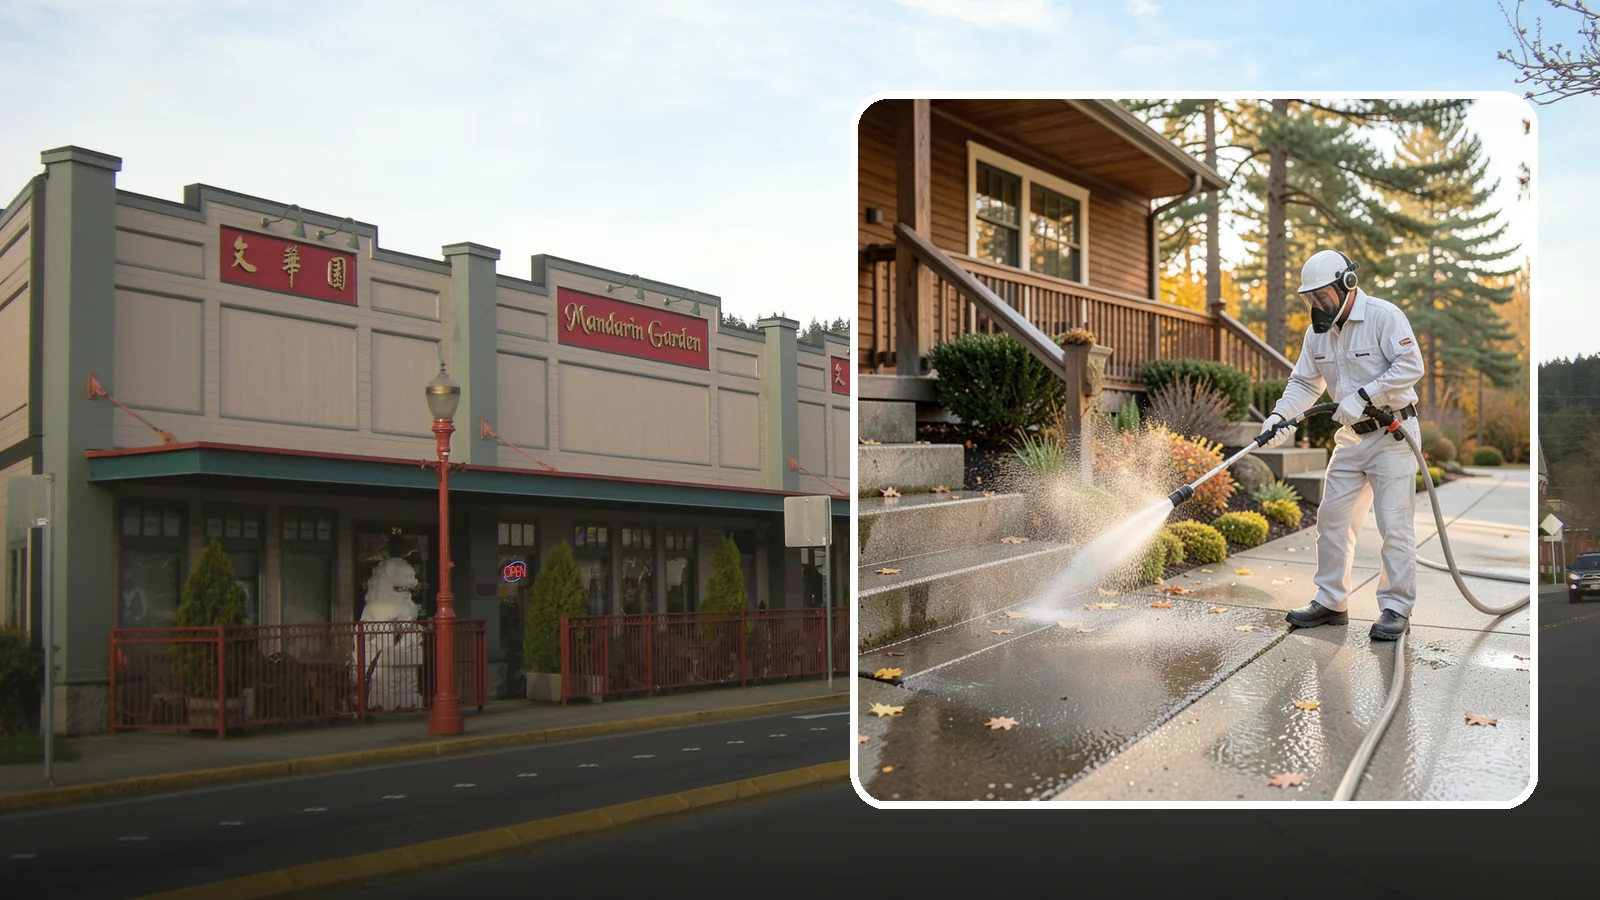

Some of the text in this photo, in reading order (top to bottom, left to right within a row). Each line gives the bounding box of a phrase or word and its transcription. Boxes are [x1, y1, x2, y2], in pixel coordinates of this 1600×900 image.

[231, 236, 346, 291] 文華園
[564, 302, 701, 352] Mandarin Garden
[503, 565, 527, 578] OPEN
